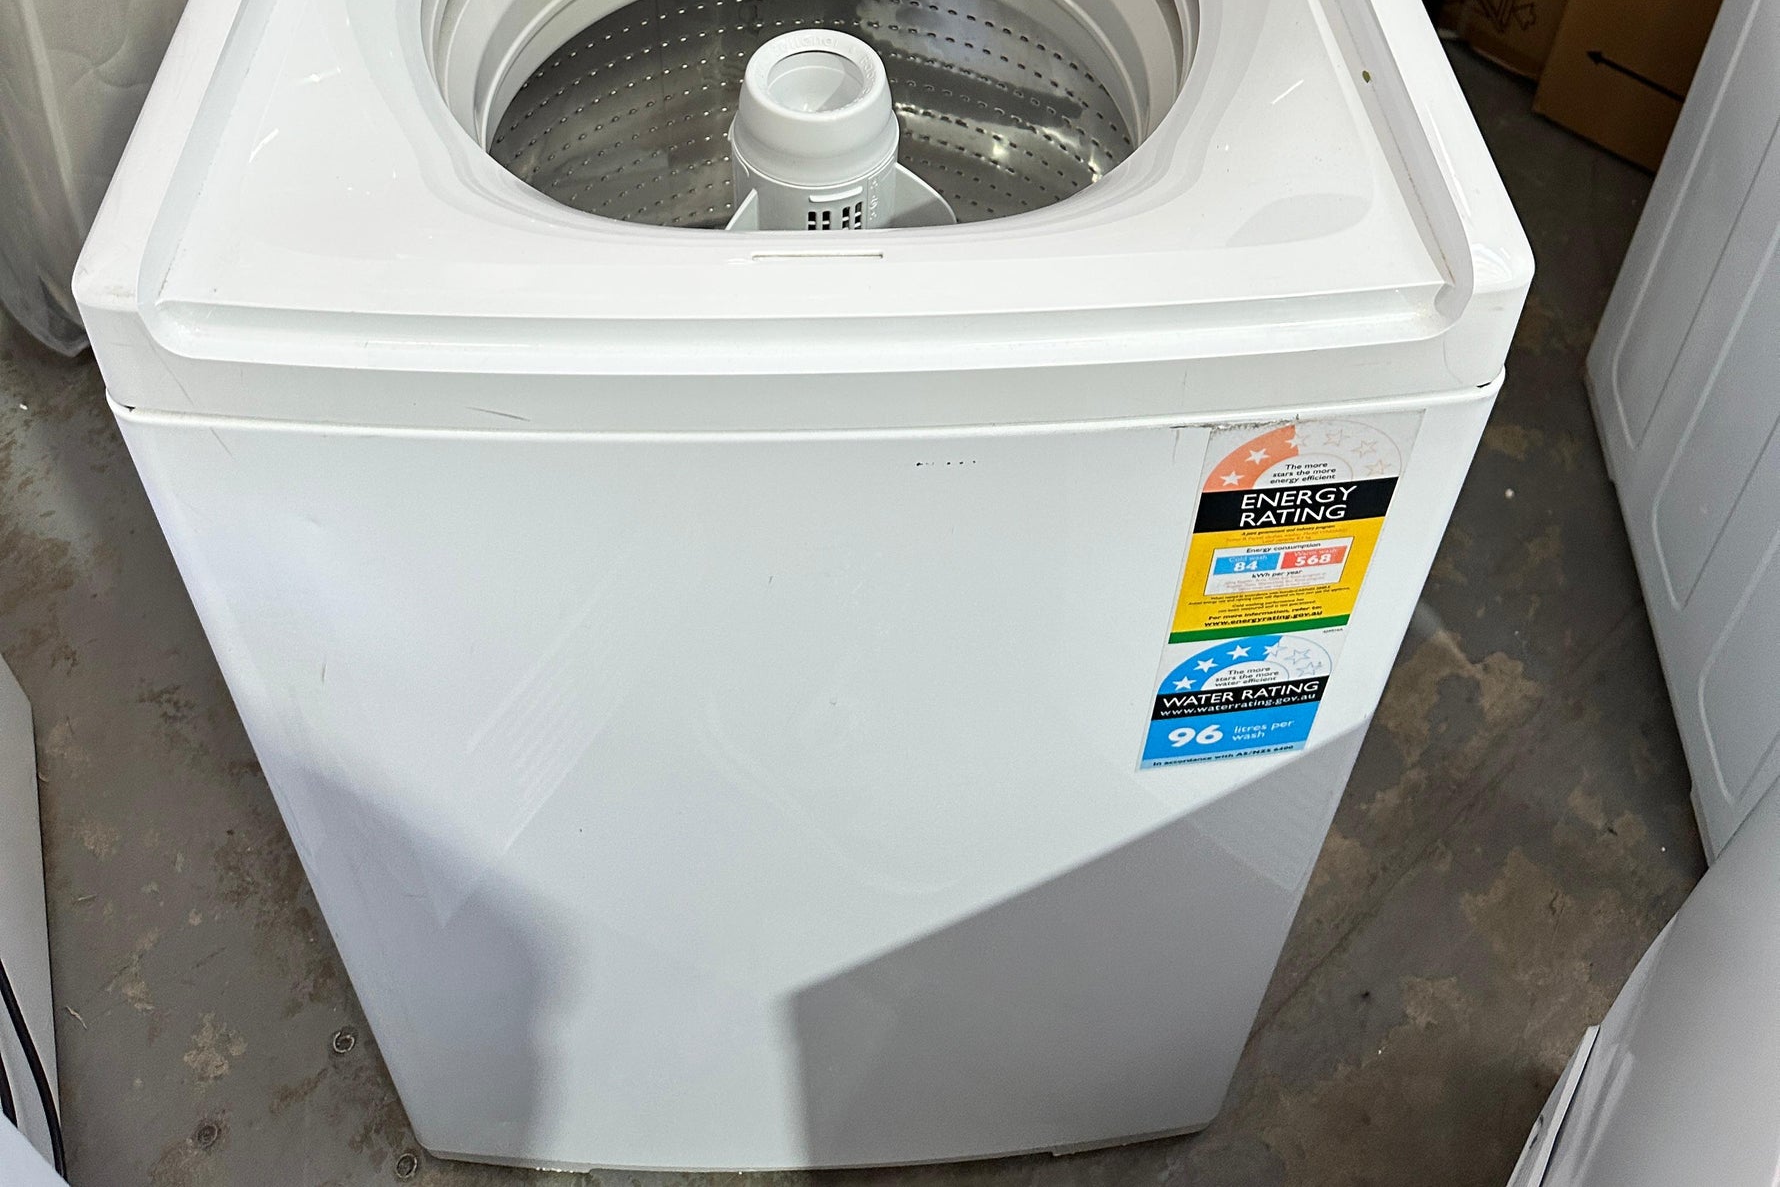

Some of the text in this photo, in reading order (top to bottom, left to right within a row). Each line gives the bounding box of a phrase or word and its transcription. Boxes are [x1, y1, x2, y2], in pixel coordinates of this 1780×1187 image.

[1301, 474, 1336, 482] efficient
[1240, 485, 1357, 510] ENERGY
[1239, 504, 1347, 527] RATING
[1233, 560, 1258, 572] 84
[1294, 553, 1332, 567] 568
[1204, 611, 1323, 628] www.energyrating.gov.au
[1162, 681, 1320, 708] WATER RATING
[1160, 693, 1316, 717] www.waterrating.gov.au
[1168, 724, 1223, 747] 96
[1234, 720, 1295, 734] litres per
[1232, 731, 1266, 741] wash
